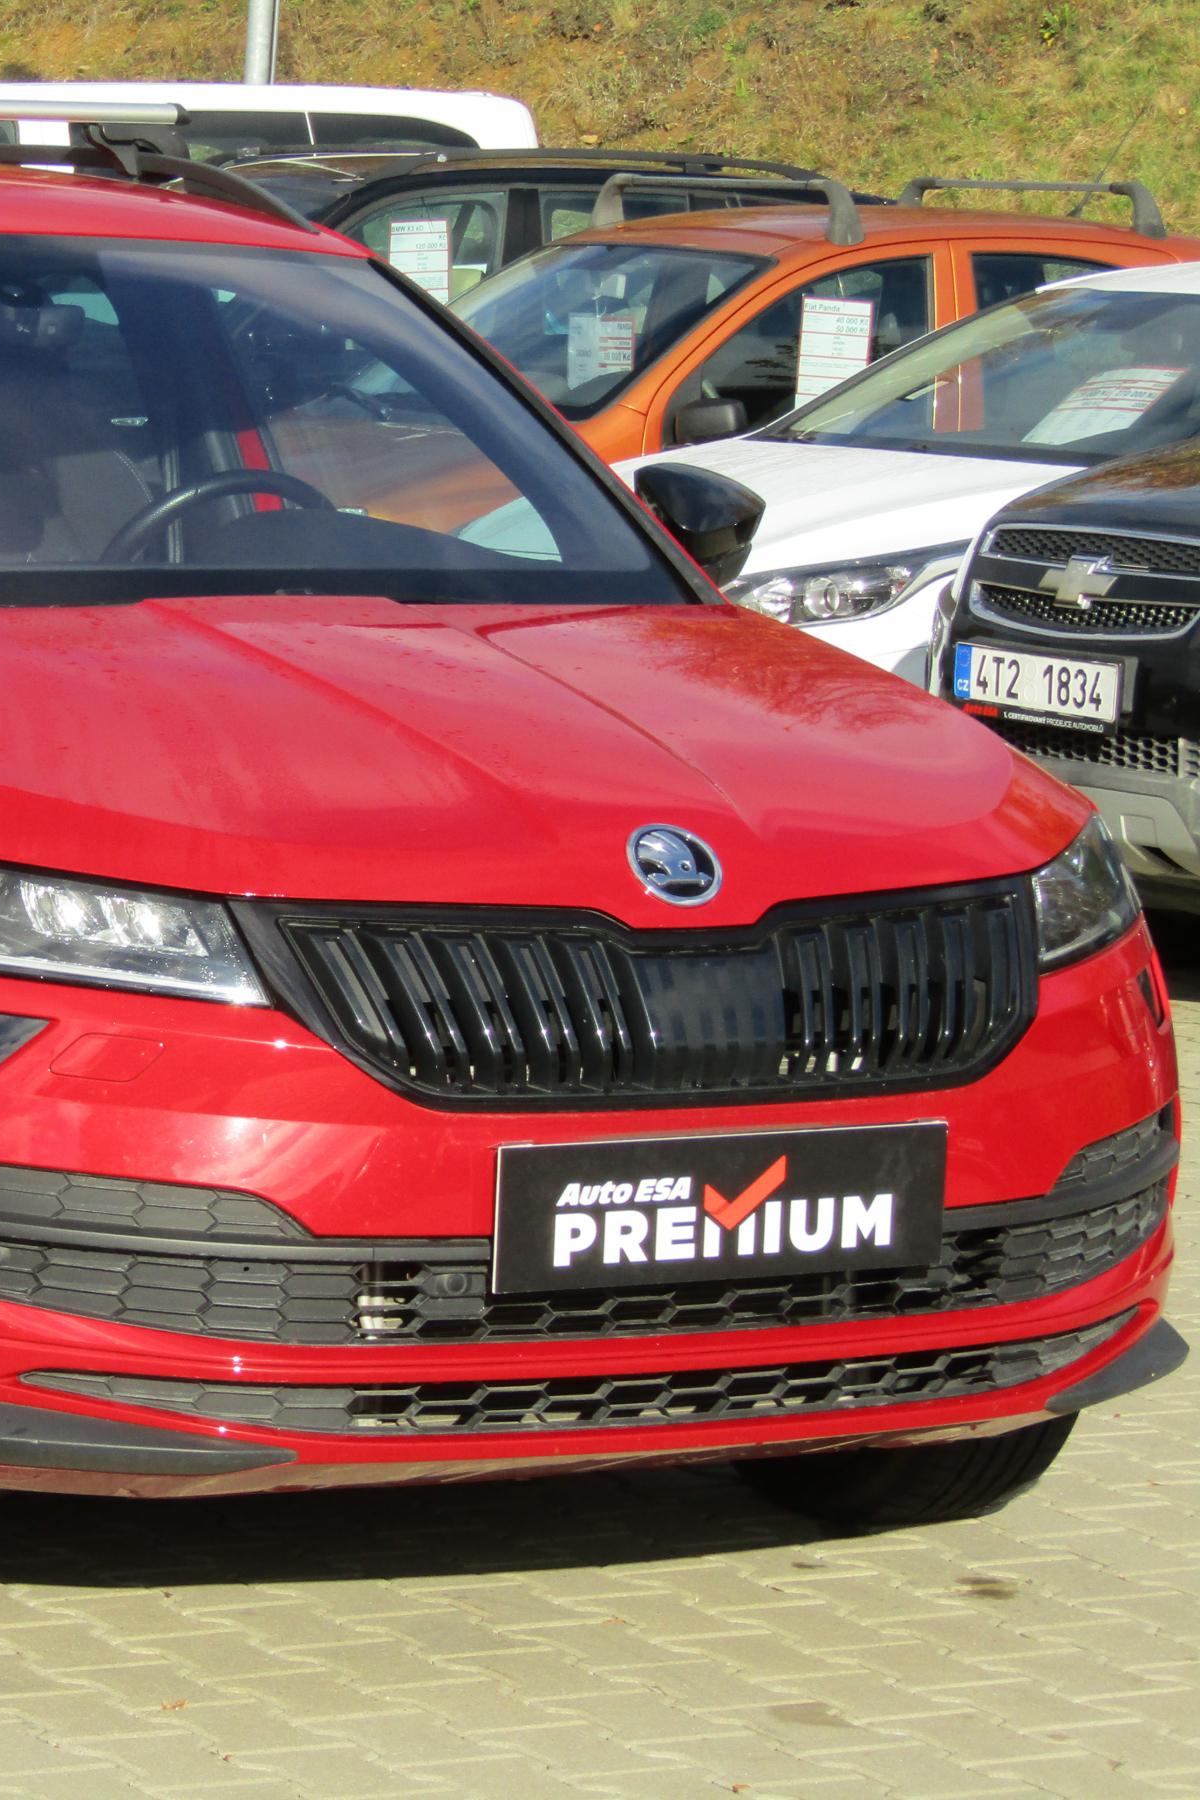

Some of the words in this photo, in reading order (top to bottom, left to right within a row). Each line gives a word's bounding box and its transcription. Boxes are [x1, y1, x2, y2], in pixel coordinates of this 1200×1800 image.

[818, 304, 840, 312] Panda
[957, 679, 969, 691] CZ
[976, 654, 1021, 699] 4T2
[1042, 664, 1102, 712] 1834
[556, 1180, 634, 1208] Auto
[634, 1176, 693, 1202] ESA
[552, 1192, 894, 1268] PREMIUM
